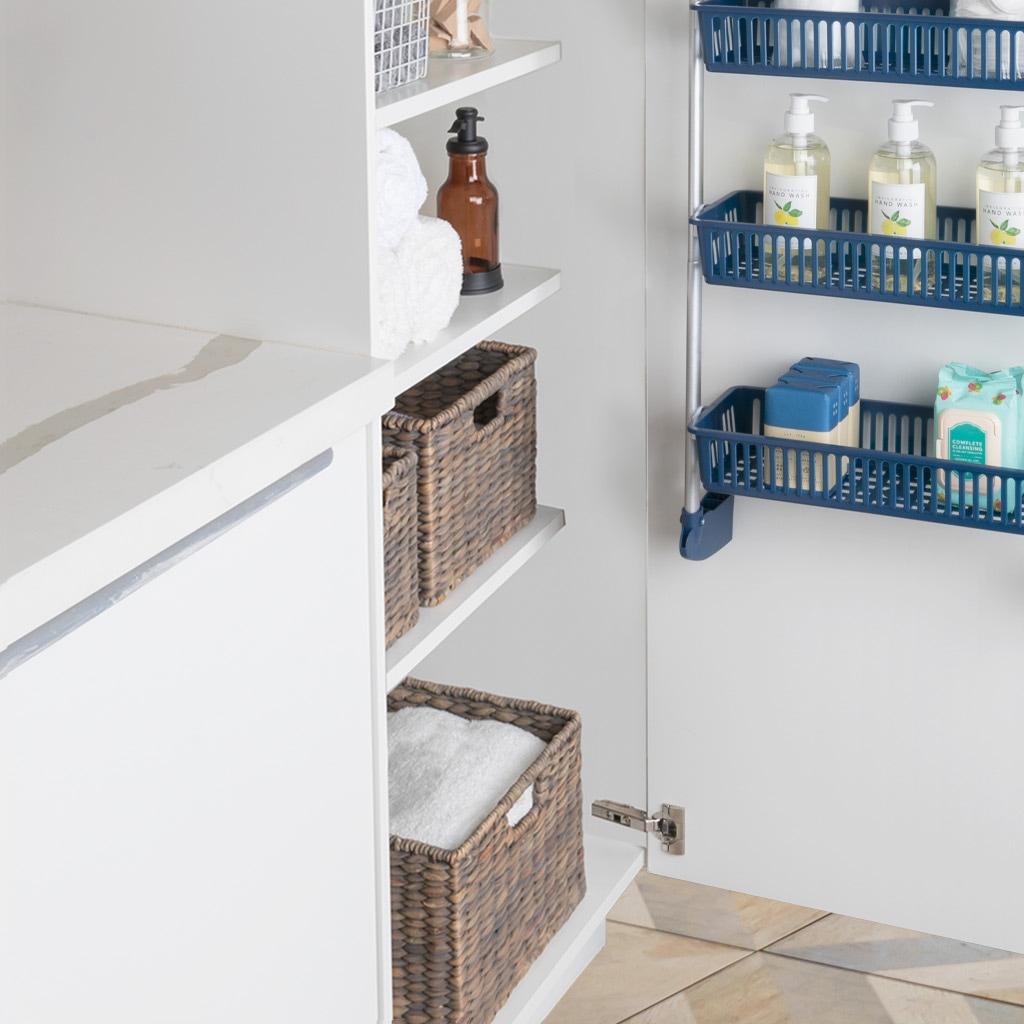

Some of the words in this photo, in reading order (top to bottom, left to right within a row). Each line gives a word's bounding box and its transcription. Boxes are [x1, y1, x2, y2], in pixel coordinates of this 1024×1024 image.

[768, 189, 786, 197] HAND
[874, 199, 893, 207] HAND
[982, 207, 1002, 216] HAND
[952, 439, 983, 447] COMPLETE
[952, 444, 983, 452] CLEANSING
